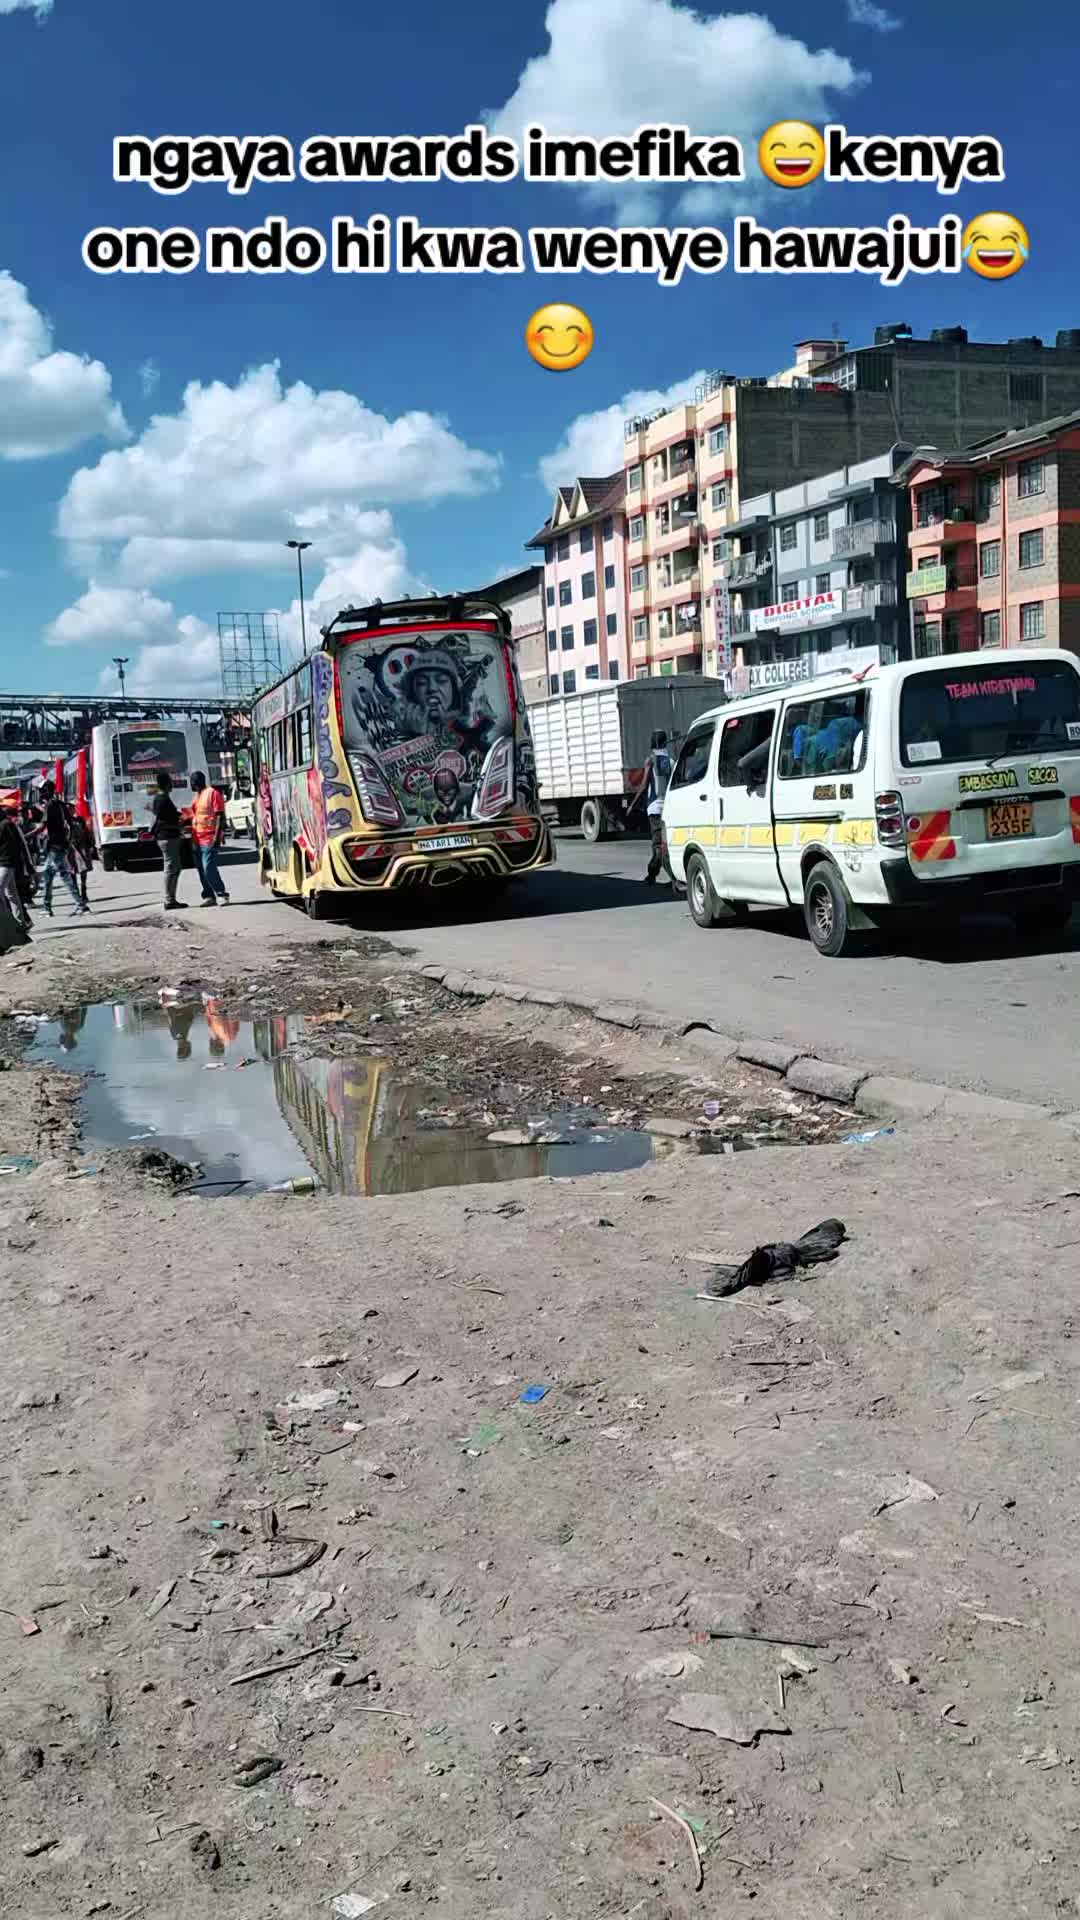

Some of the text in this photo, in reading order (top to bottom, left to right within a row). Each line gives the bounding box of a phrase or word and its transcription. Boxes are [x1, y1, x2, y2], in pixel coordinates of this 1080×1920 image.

[764, 592, 835, 617] DIGITAL
[801, 604, 836, 618] SCHOOL
[764, 660, 809, 684] COLLEGE
[945, 682, 979, 698] TEAM
[991, 819, 1031, 836] 235F
